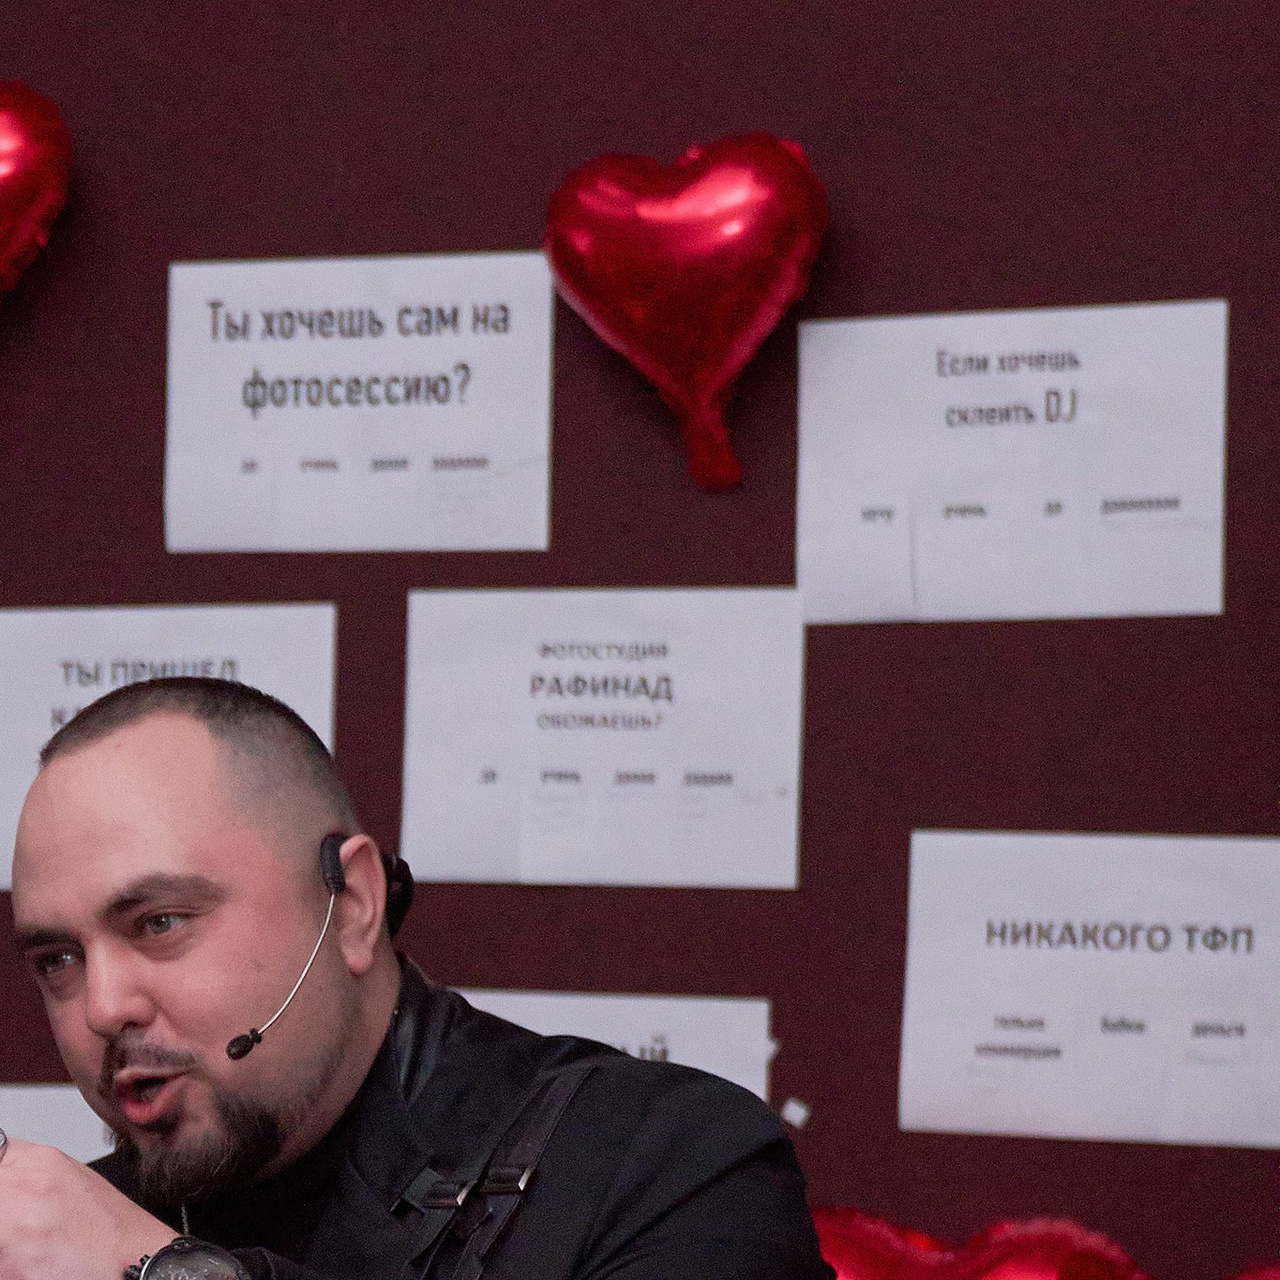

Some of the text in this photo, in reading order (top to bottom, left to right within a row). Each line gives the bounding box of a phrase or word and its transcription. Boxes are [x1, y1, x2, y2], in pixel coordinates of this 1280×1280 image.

[206, 298, 512, 342] Ты хочешь сам на
[935, 349, 1082, 378] Если хочешь
[241, 361, 472, 419] фотосессию?
[944, 387, 1079, 428] склеить DJ
[60, 659, 103, 688] ТЫ
[529, 674, 675, 704] РАФИНАД
[985, 920, 1255, 954] НИКАКОГО ТФП
